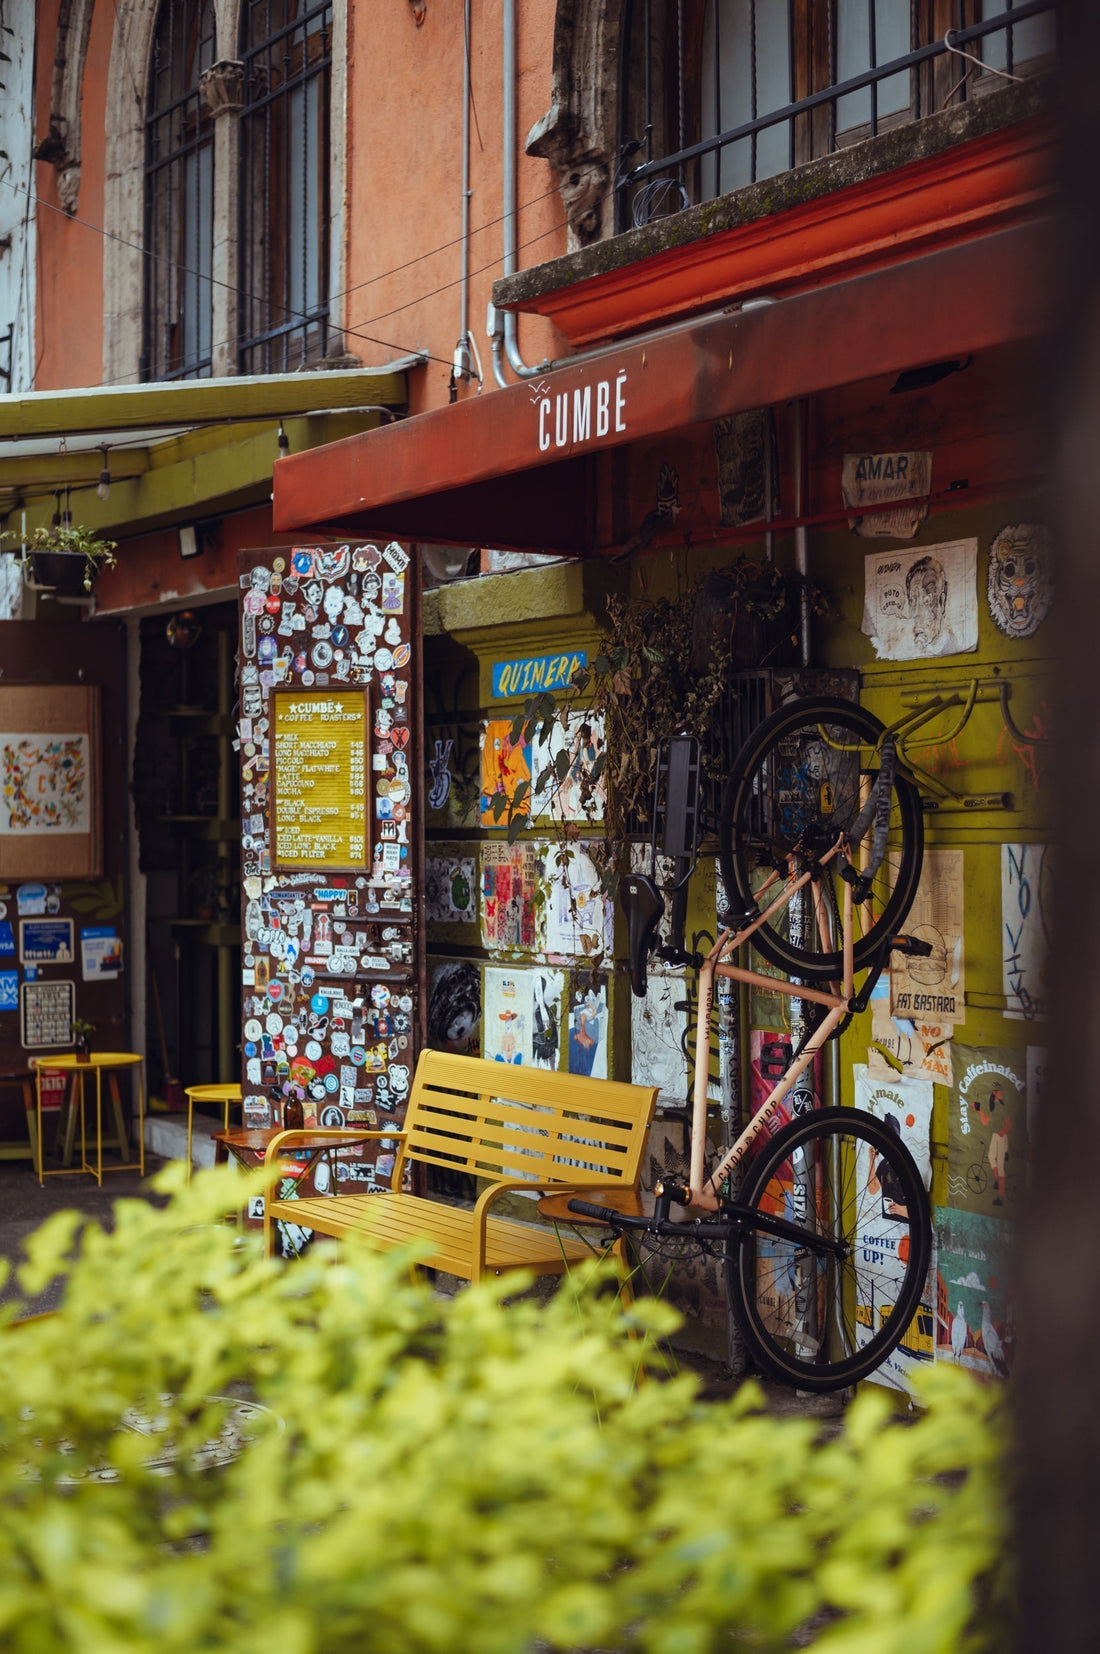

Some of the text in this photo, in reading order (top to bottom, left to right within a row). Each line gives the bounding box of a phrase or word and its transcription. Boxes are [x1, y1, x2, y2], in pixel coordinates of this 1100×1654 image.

[855, 455, 909, 481] AMAR
[498, 655, 581, 697] QUIMERA
[284, 713, 357, 722] COFFEE ROASTERS
[275, 741, 297, 749] SHORT
[299, 741, 337, 749] MACCHIATO
[275, 749, 292, 757] LONG
[293, 749, 330, 757] MACCHIATO
[275, 757, 304, 765] PICCOLO
[277, 788, 302, 796] MOCHA
[284, 799, 306, 807] BLACK
[276, 807, 302, 815] DOUBLE
[304, 807, 339, 815] ESPRESSO
[277, 815, 296, 823] LONG
[299, 815, 322, 823] BLACK
[277, 834, 292, 842] ICED
[277, 842, 292, 850] ICED
[294, 842, 312, 850] LONG
[313, 843, 337, 851] BLACK
[301, 850, 326, 858] FILTER
[896, 993, 956, 1014] FAT BASTARD
[921, 1024, 942, 1038] NO
[875, 1088, 905, 1109] mate
[958, 1060, 1026, 1135] Stay Caffeinated
[863, 1234, 896, 1250] COFFEE
[863, 1249, 884, 1266] UP!
